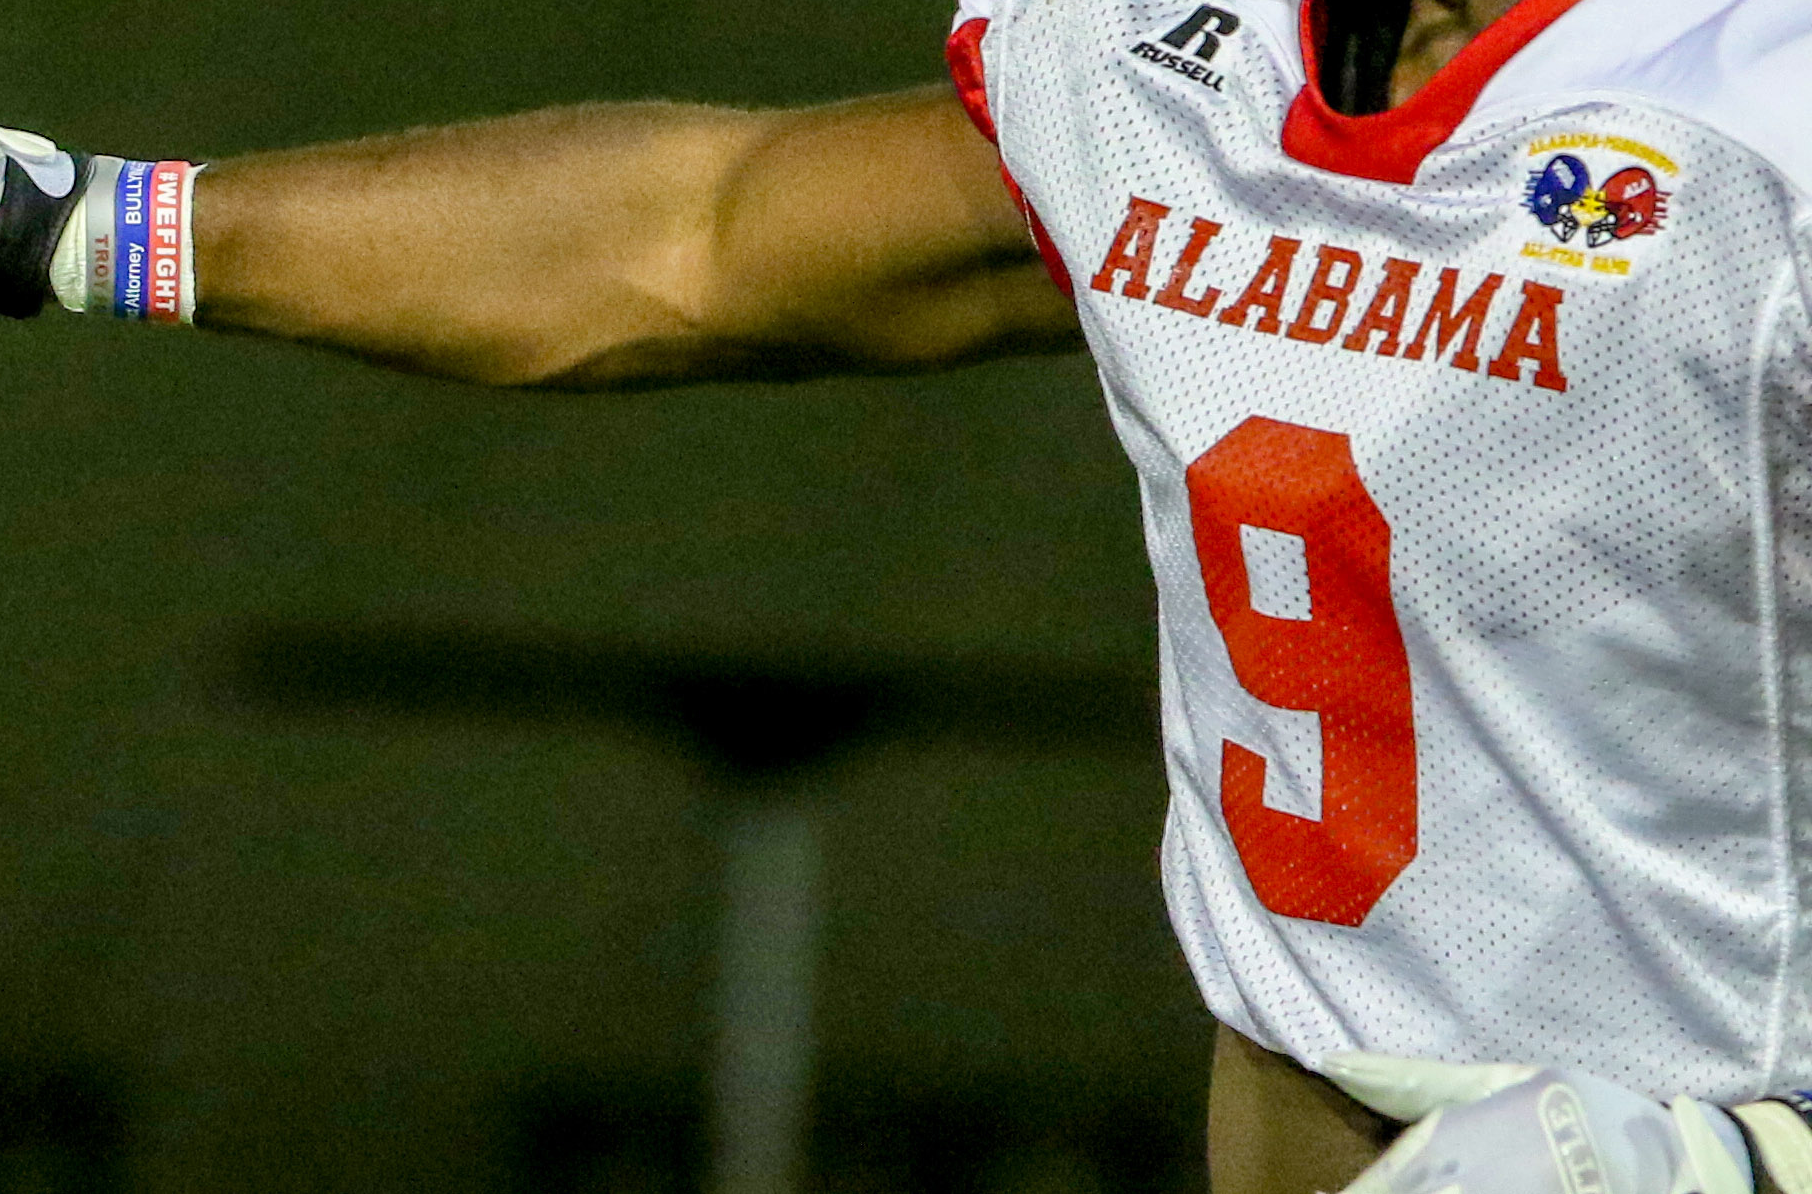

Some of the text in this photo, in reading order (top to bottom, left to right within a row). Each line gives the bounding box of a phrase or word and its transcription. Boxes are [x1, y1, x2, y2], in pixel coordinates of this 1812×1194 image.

[1129, 41, 1225, 93] RUSSELL
[1158, 2, 1240, 63] R
[124, 243, 145, 307] Attorney
[155, 172, 179, 313] #WEFIGHT
[1090, 195, 1568, 393] ALABAMA
[1186, 414, 1419, 928] 9
